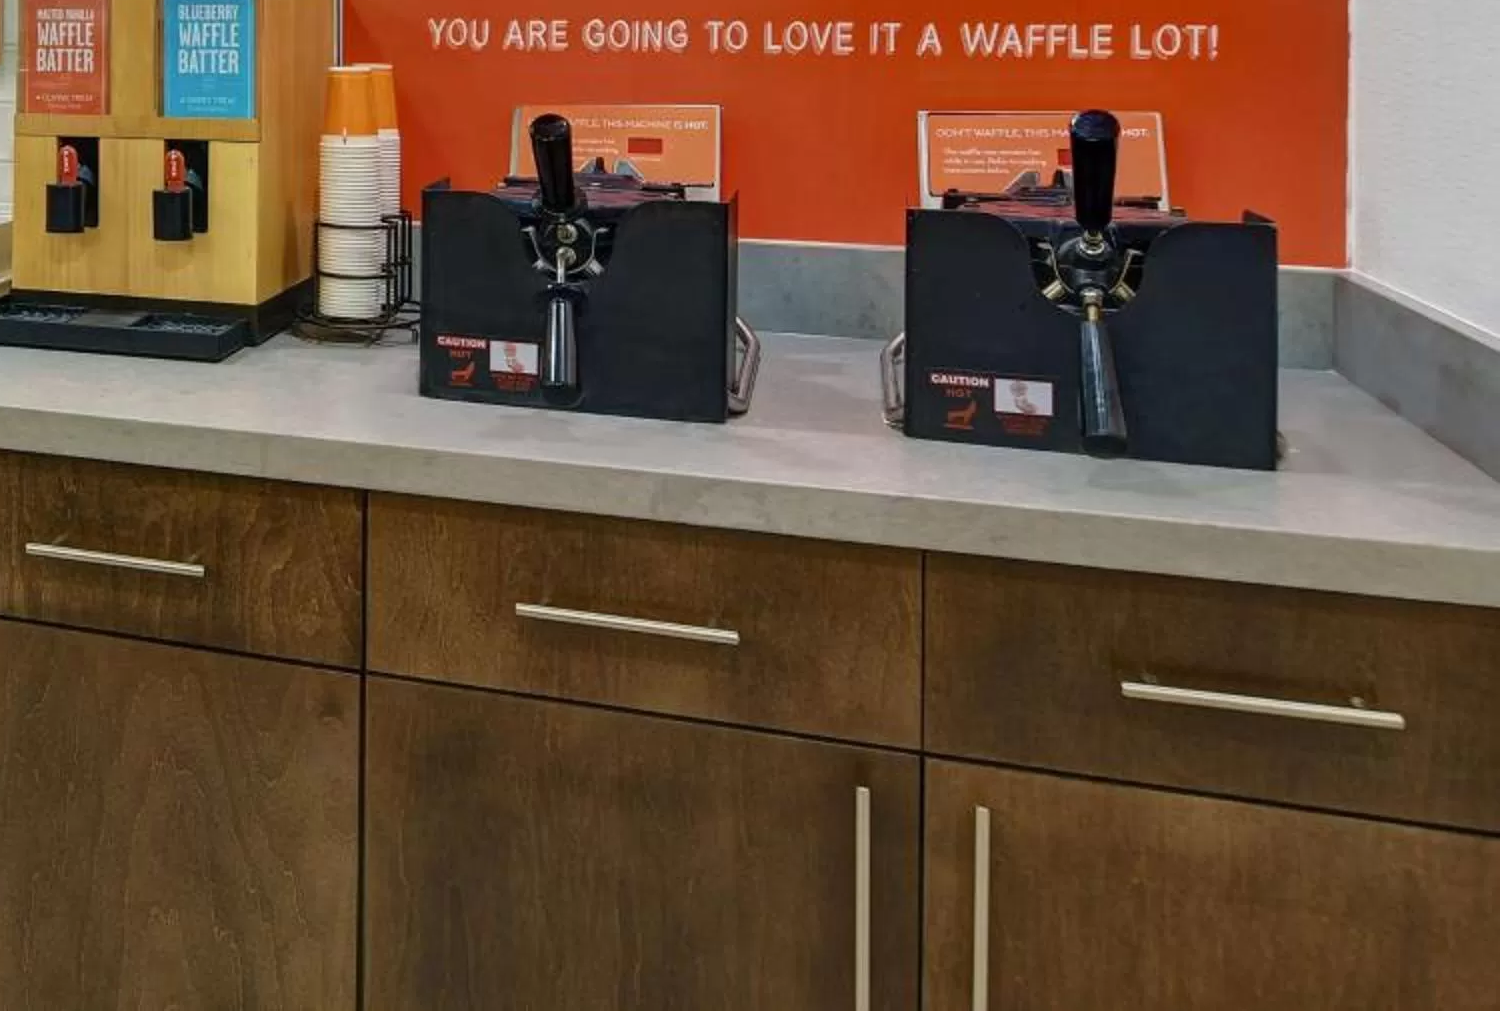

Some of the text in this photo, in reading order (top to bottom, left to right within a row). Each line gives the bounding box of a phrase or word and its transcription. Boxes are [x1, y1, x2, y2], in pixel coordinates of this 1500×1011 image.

[177, 4, 239, 20] BLUEBERRY
[37, 22, 94, 47] WAFFLE
[178, 22, 240, 48] WAFFLE
[428, 18, 1220, 62] YOU ARE GOING TO LOVE IT A WAFFLE LOT!
[36, 48, 94, 73] BATTER
[177, 49, 240, 75] BATTER
[436, 335, 487, 350] CAUTION
[930, 373, 990, 388] CAUTION
